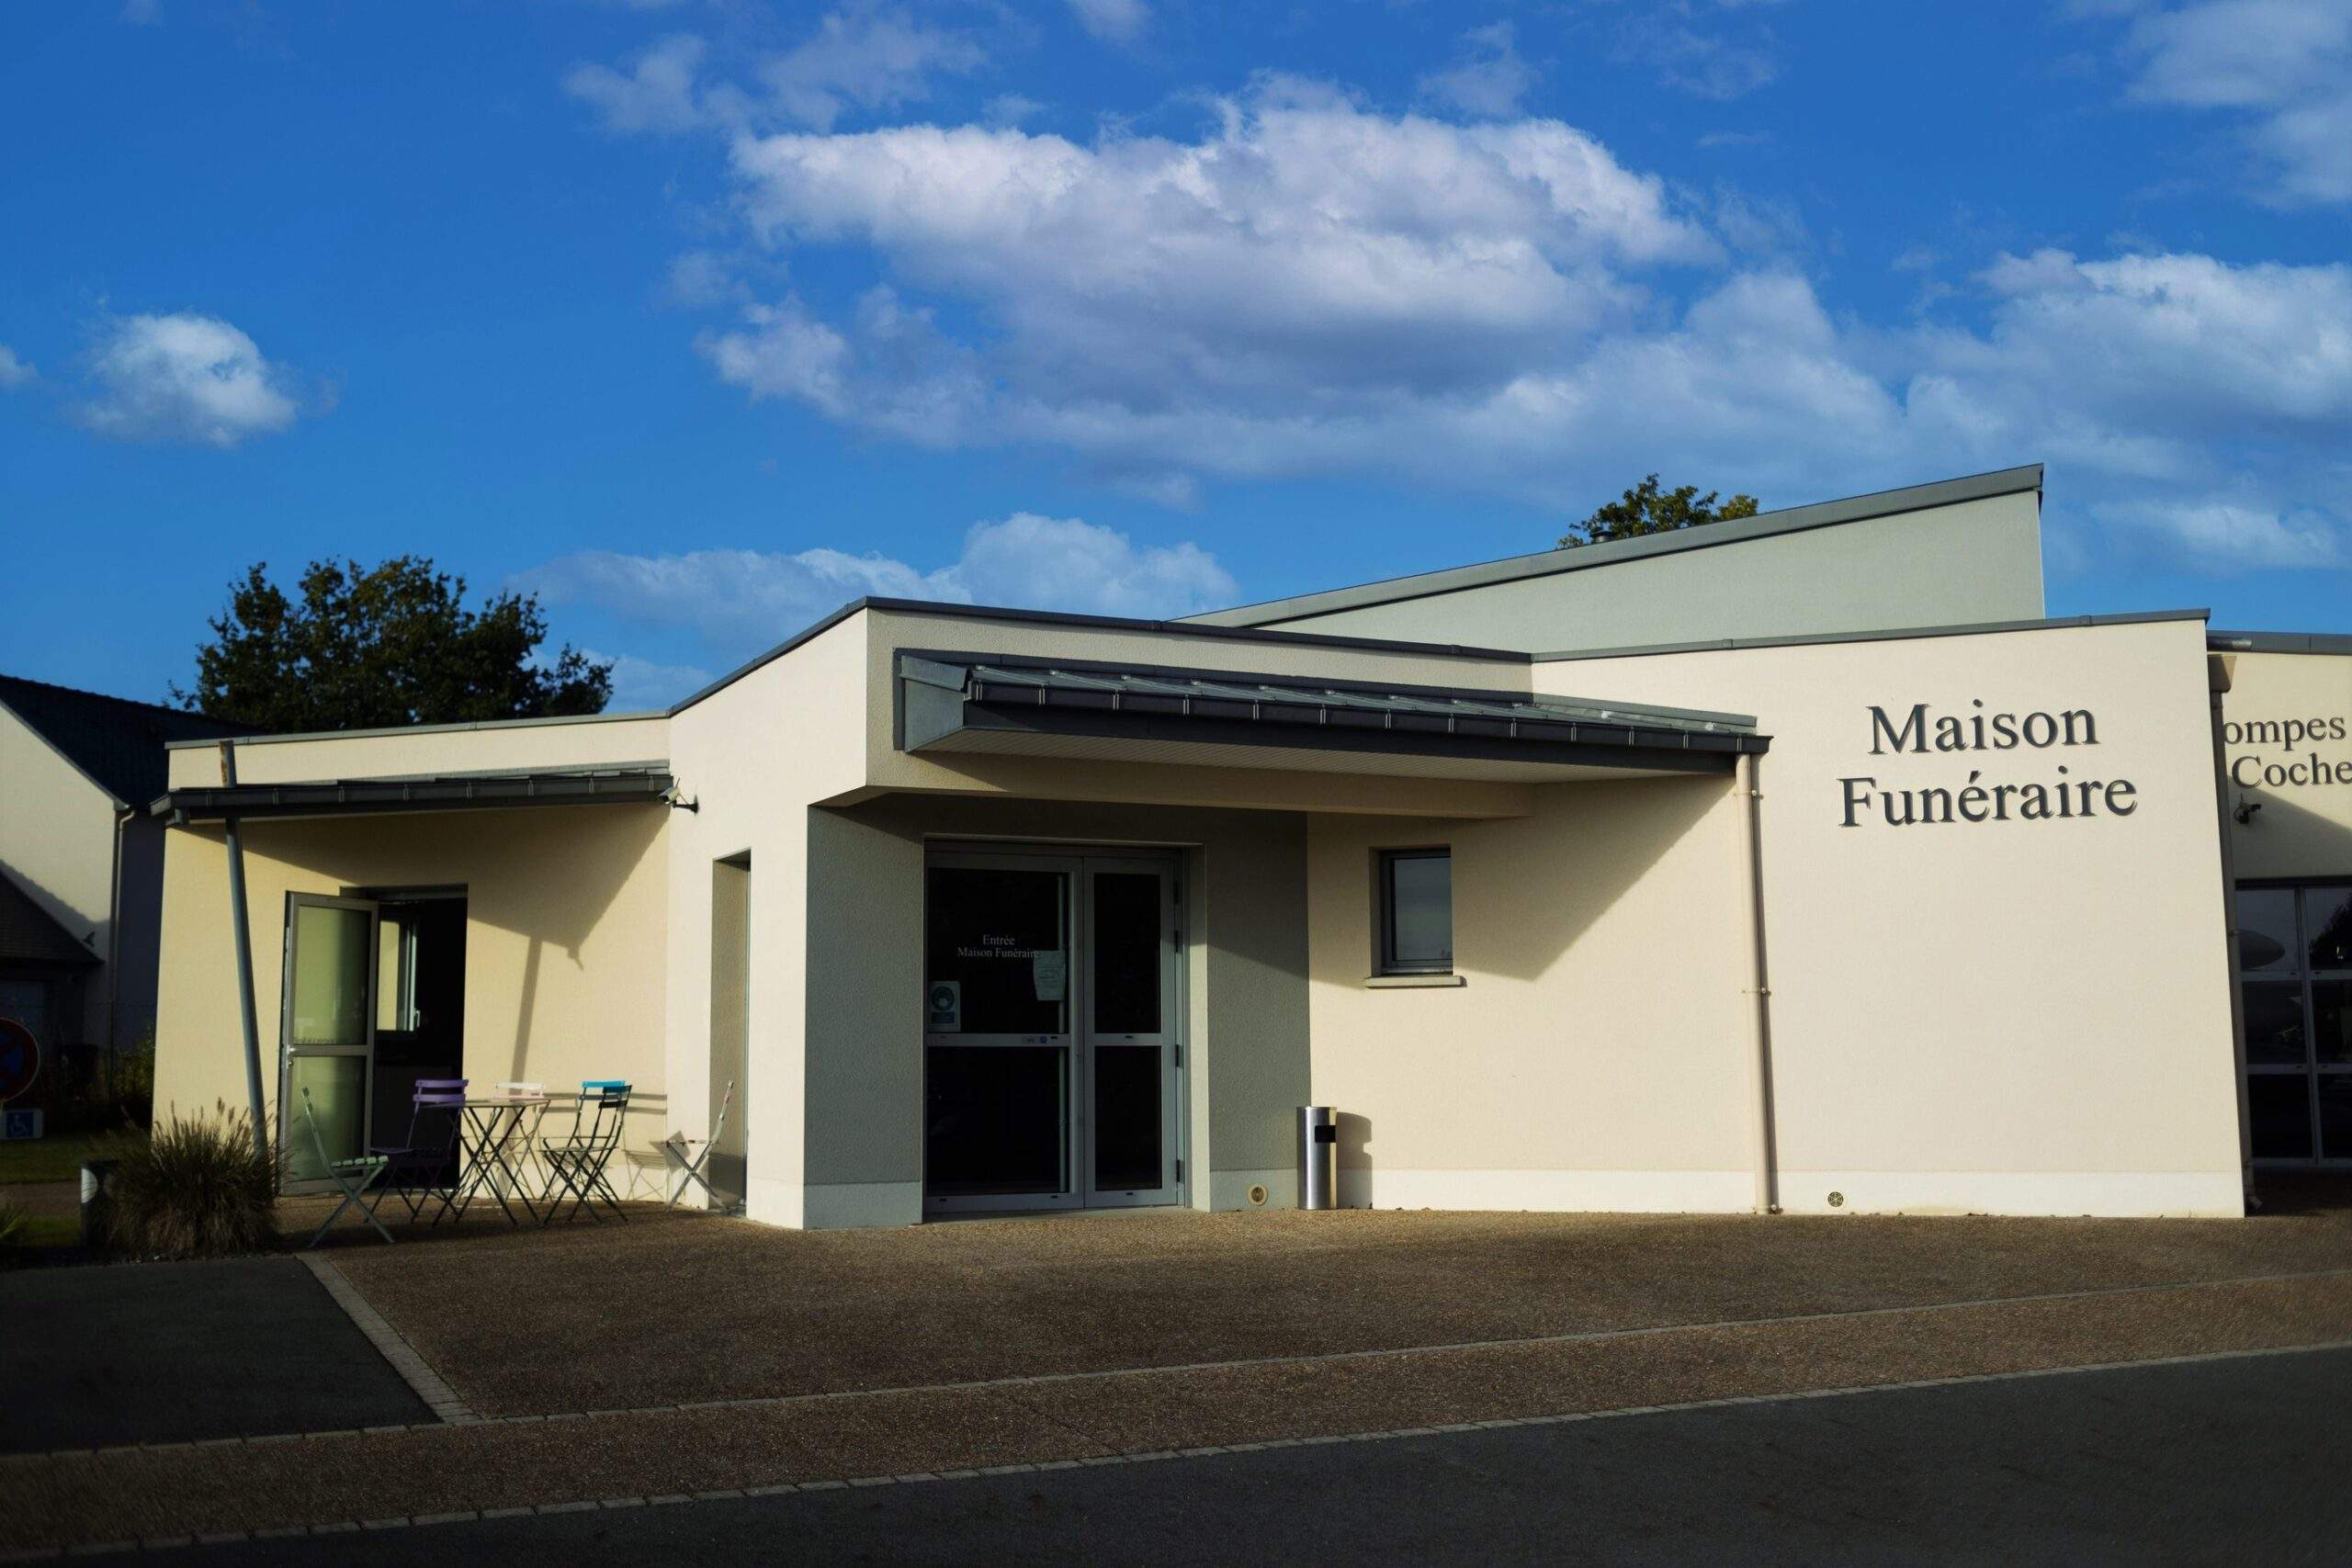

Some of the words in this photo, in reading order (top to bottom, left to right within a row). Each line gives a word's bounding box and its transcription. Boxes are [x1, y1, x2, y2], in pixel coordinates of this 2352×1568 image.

[1866, 699, 2101, 755] Maison
[2222, 716, 2346, 751] ompes
[2232, 751, 2352, 788] Coche
[1837, 765, 2138, 828] Funéraire
[956, 947, 992, 957] Maison
[982, 934, 1015, 945] Entrée
